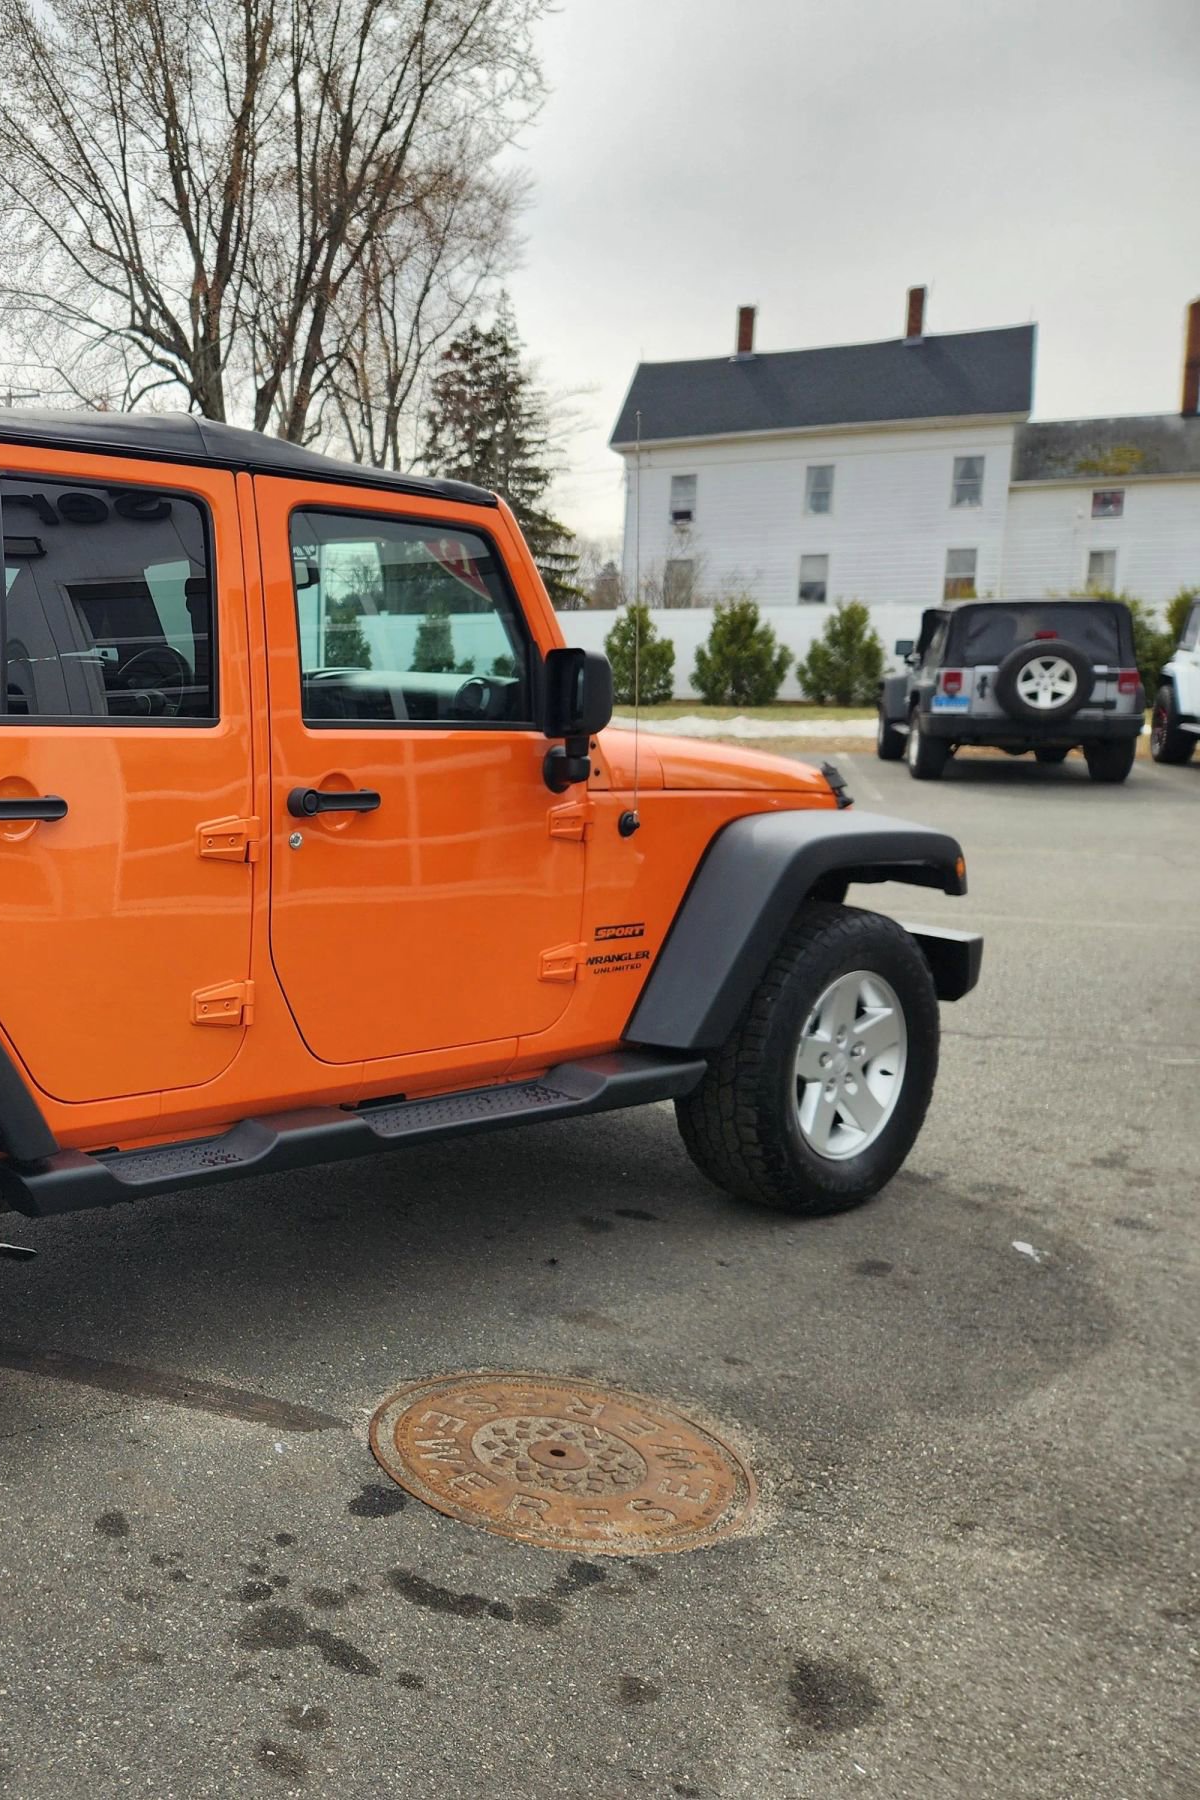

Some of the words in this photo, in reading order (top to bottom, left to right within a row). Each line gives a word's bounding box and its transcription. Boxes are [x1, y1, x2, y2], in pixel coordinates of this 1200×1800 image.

[596, 925, 645, 940] SPORT
[586, 951, 650, 966] WRANGLER
[593, 963, 641, 975] UNLIMITED
